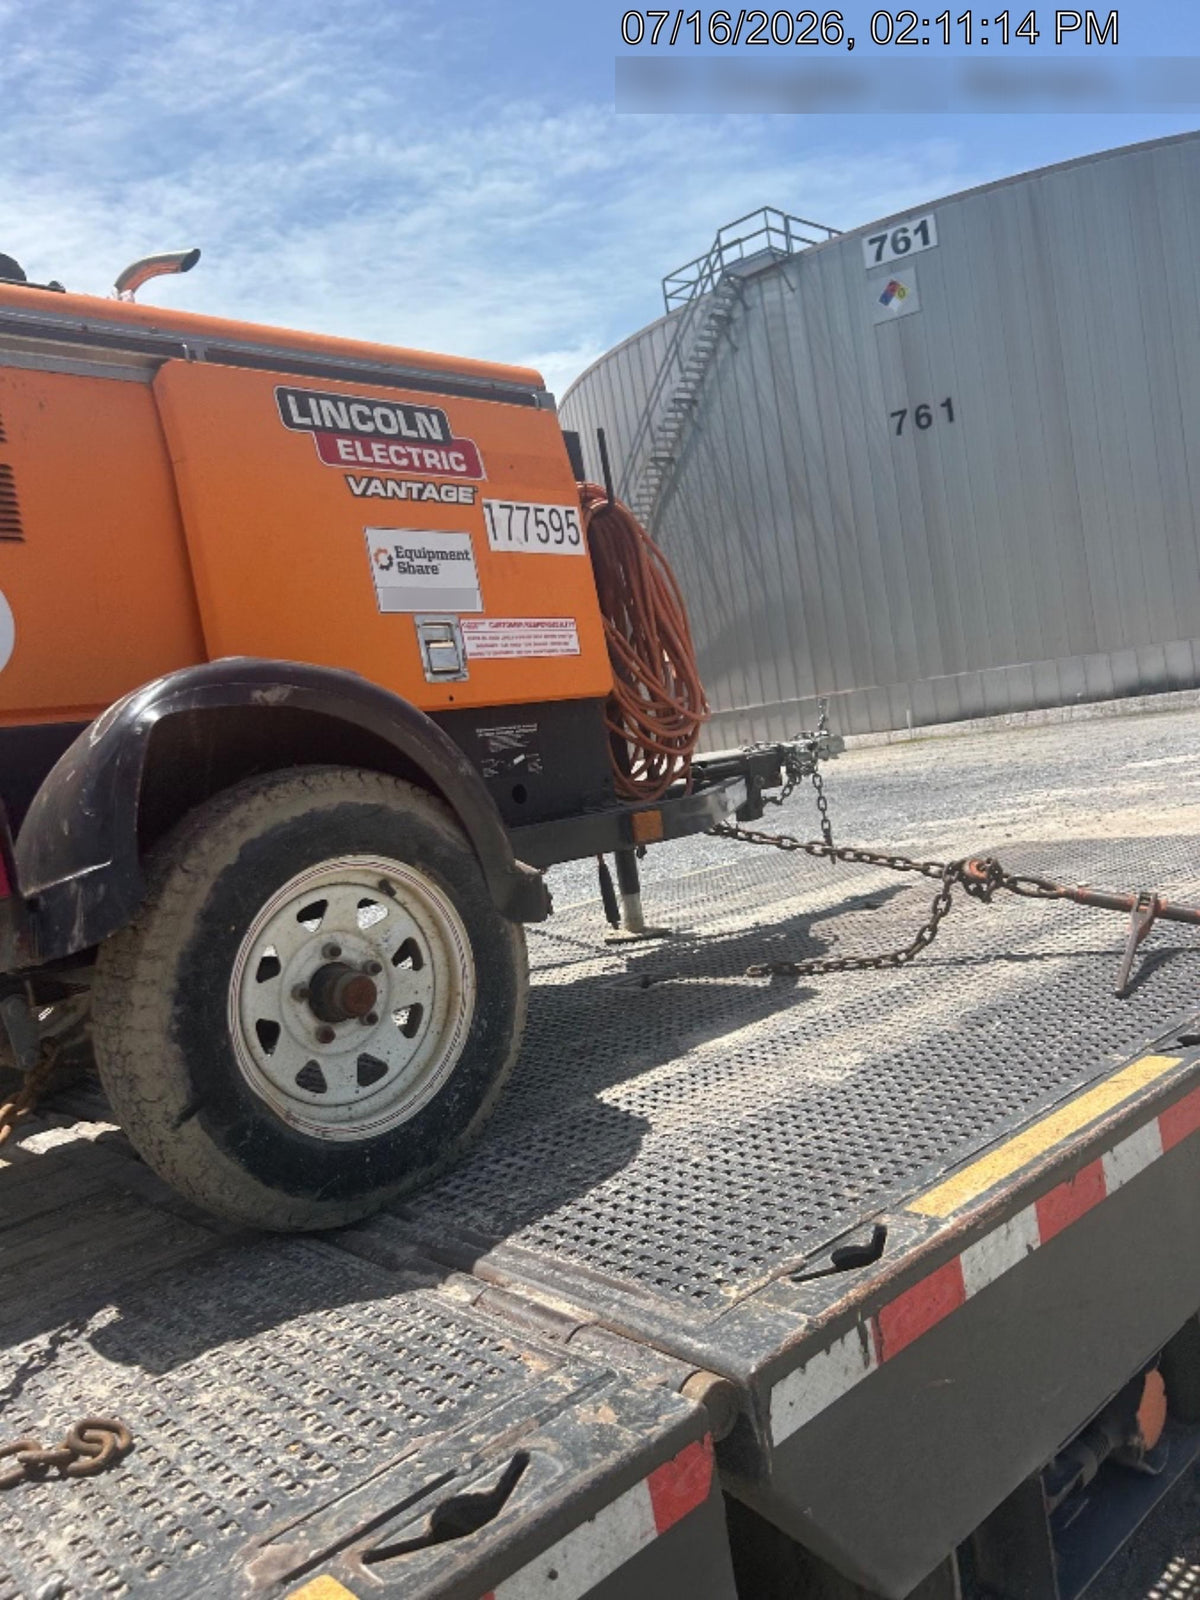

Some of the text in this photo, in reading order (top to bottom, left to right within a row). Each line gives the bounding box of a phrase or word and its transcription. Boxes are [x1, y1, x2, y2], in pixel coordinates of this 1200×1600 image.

[868, 219, 930, 262] 761
[287, 394, 443, 441] LINCOLN
[890, 397, 955, 436] 761
[336, 438, 467, 472] ELECTRIC
[346, 475, 475, 504] VANTAGE
[485, 503, 580, 545] 177595
[394, 545, 471, 562] Equipment
[397, 561, 439, 575] Share
